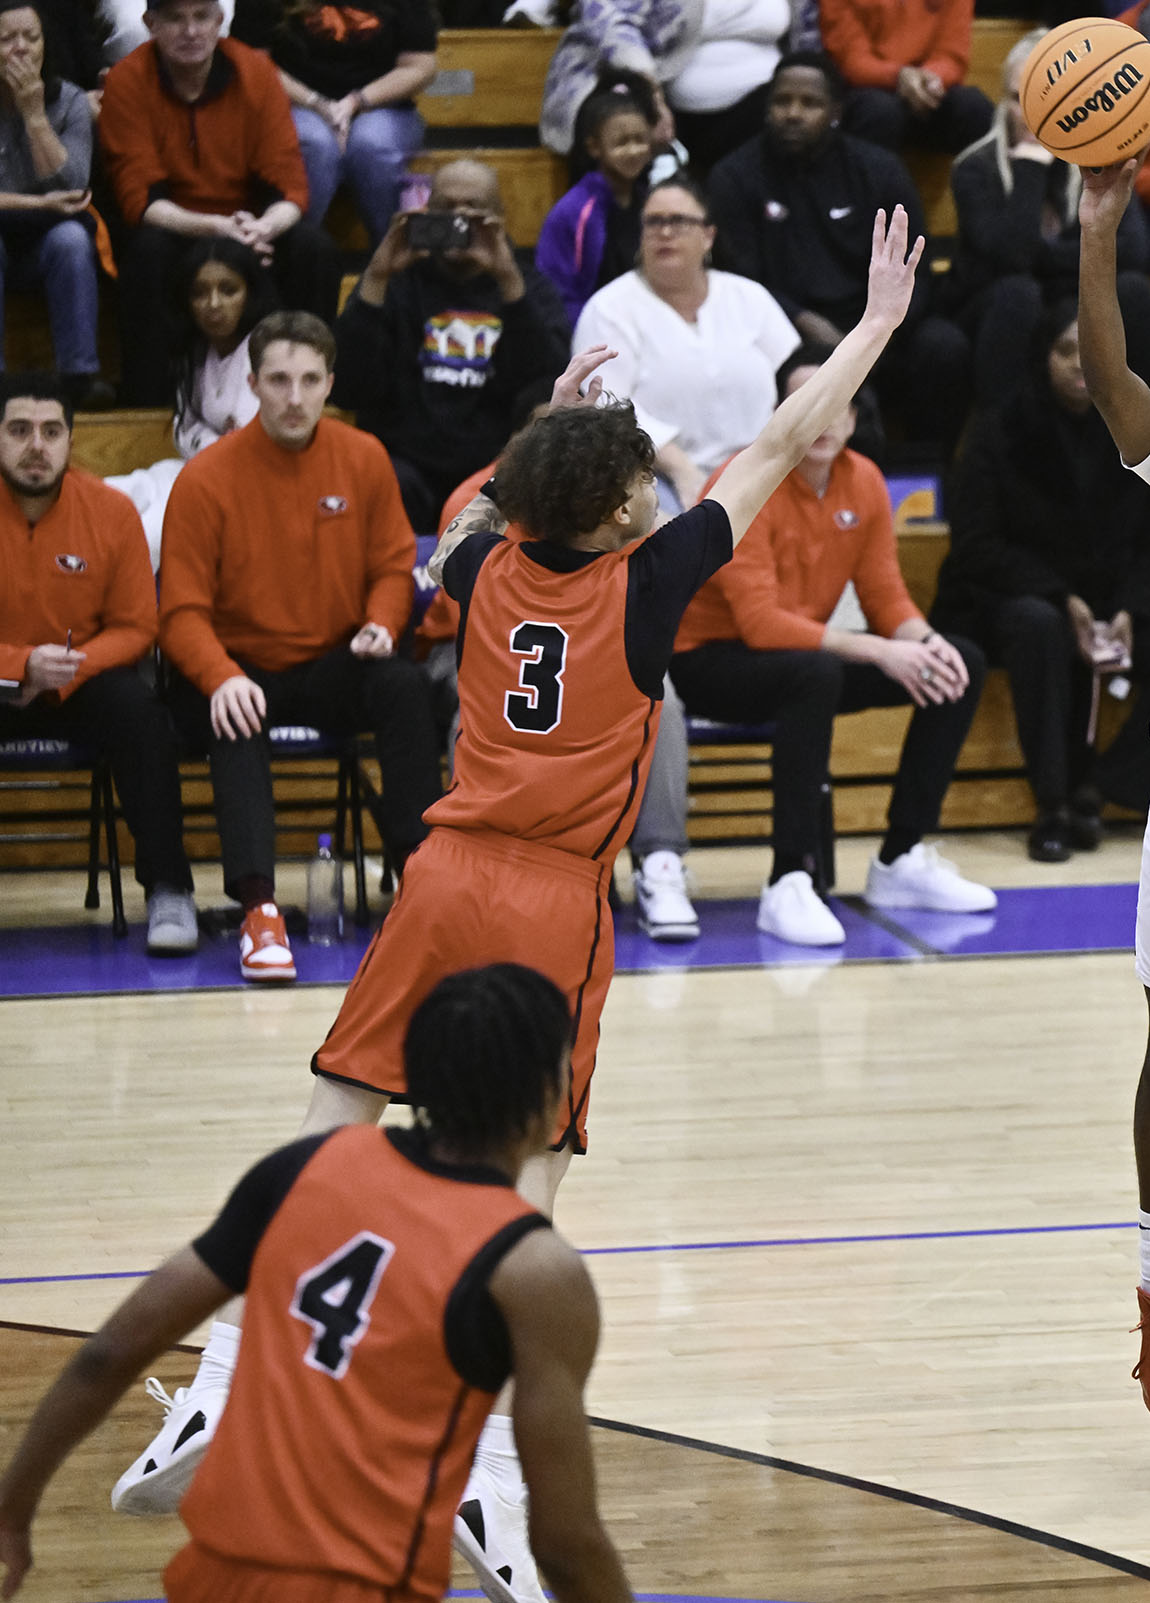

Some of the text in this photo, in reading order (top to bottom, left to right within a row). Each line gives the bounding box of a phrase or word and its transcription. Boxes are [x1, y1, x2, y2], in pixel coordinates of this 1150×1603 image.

[1056, 63, 1144, 133] Wilson
[504, 620, 569, 735] 3
[288, 1230, 396, 1381] 4
